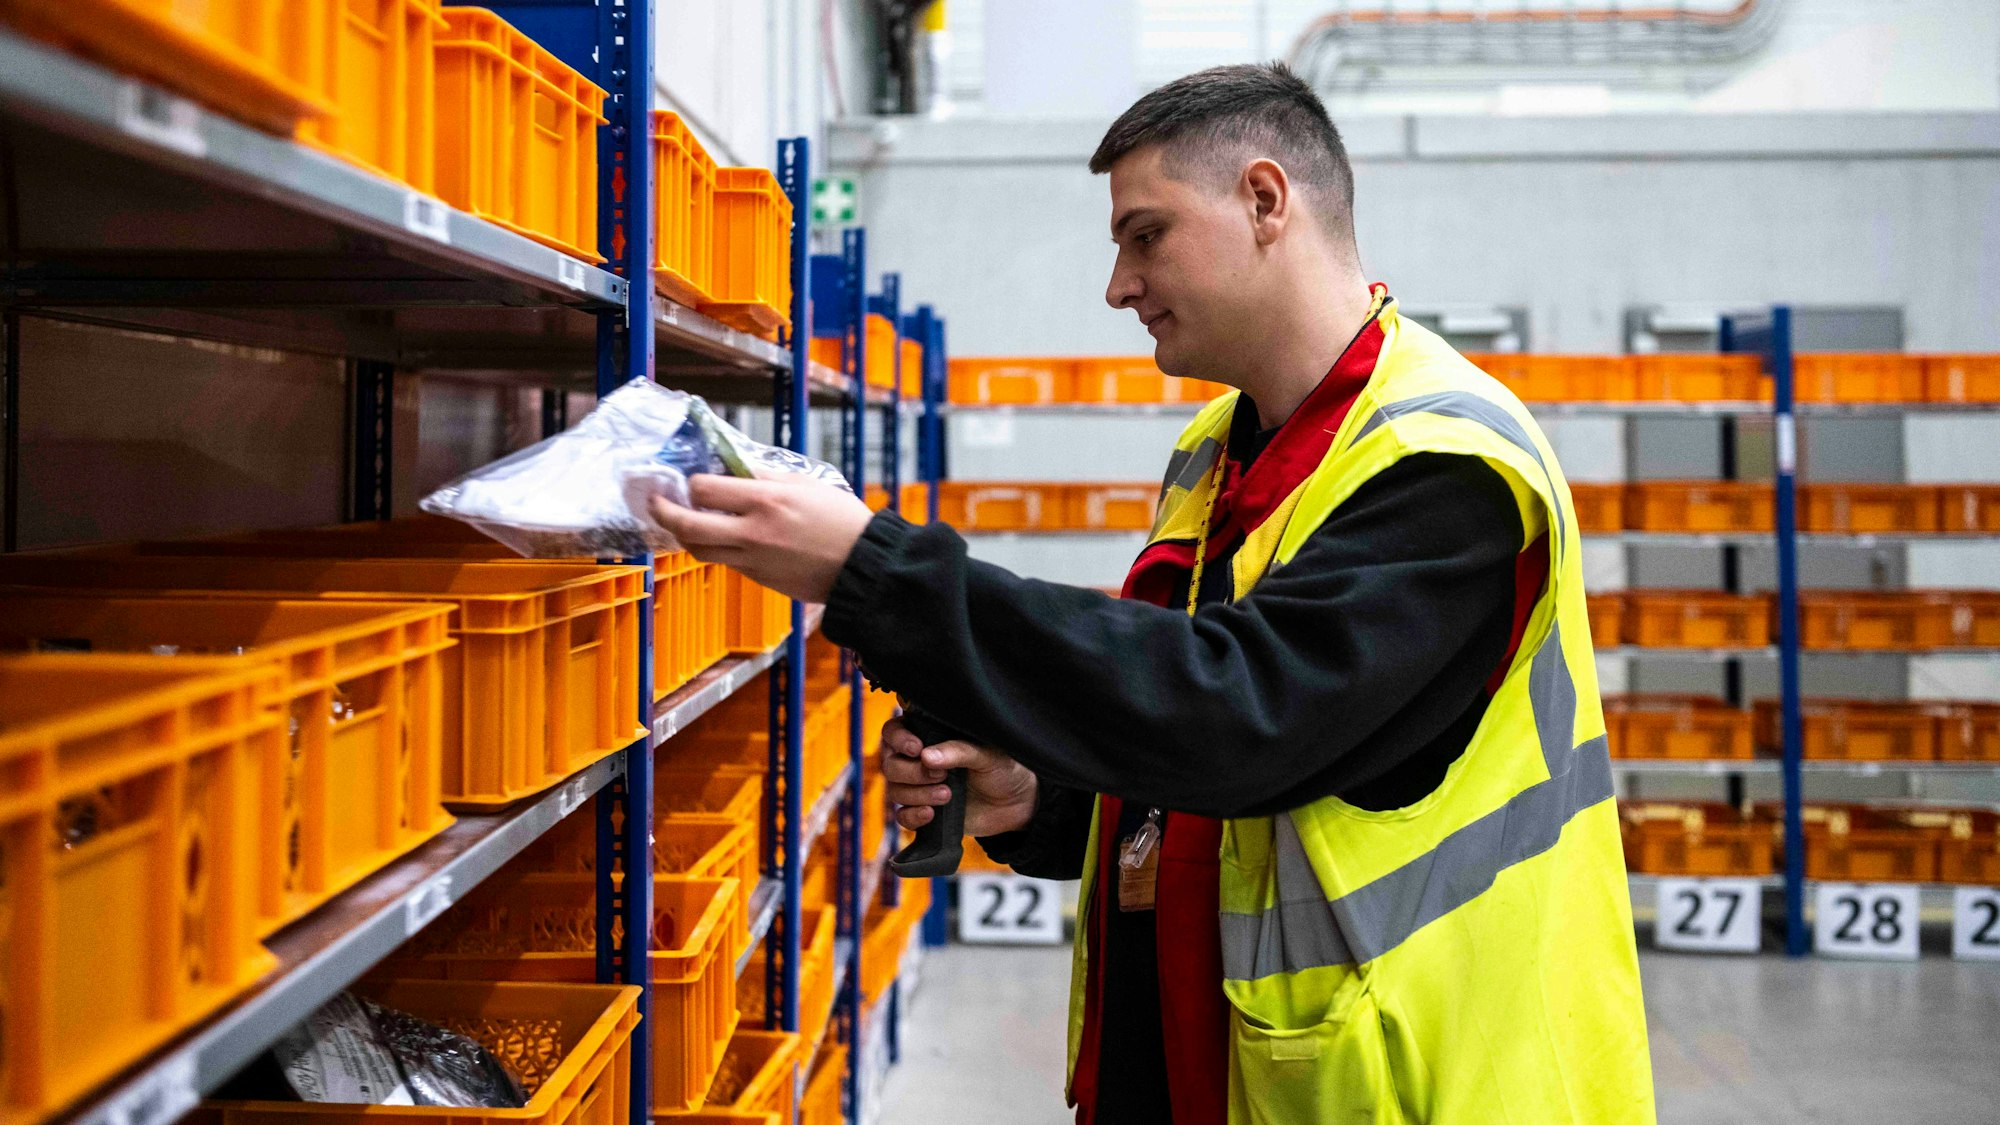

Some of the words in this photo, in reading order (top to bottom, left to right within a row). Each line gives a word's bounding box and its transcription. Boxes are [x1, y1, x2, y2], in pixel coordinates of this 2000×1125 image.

[980, 883, 1043, 928] 22
[1675, 889, 1742, 936] 27
[1833, 896, 1903, 944] 28
[1971, 899, 2000, 946] 2
